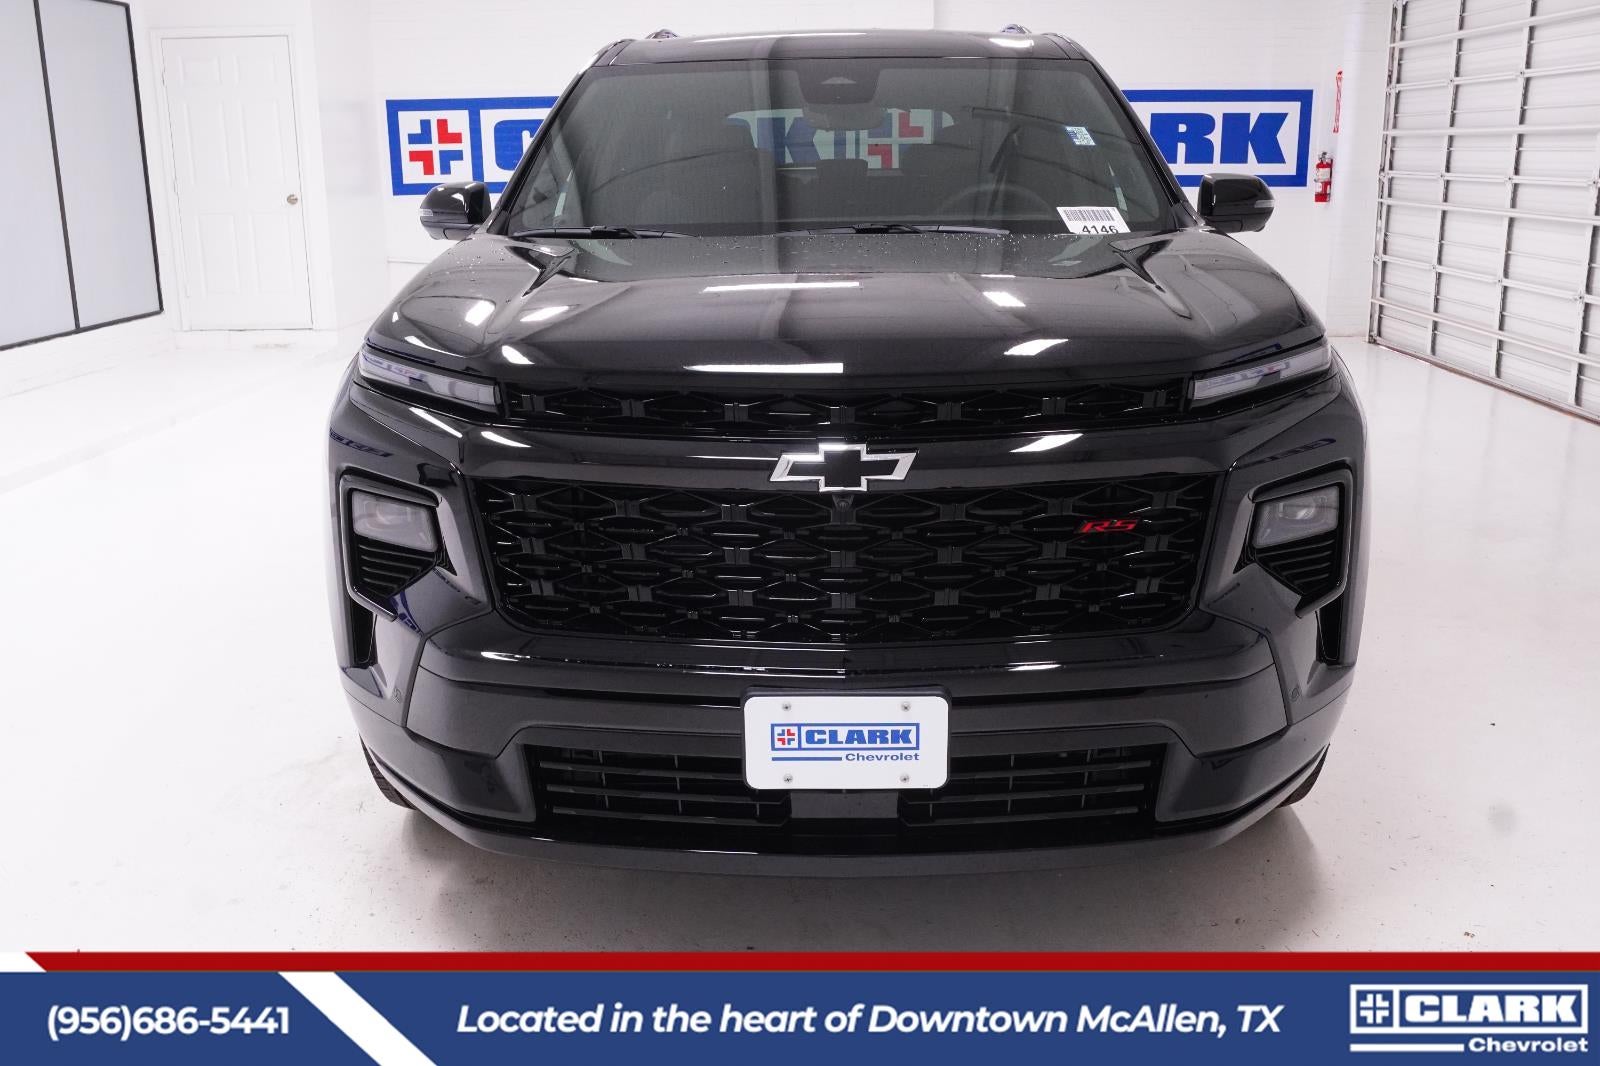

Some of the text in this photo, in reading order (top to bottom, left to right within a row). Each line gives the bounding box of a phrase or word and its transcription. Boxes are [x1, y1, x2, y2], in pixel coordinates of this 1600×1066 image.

[1081, 225, 1119, 235] 4146
[1080, 519, 1138, 534] RS
[804, 728, 913, 746] CLARK
[844, 752, 920, 762] Chevrolet
